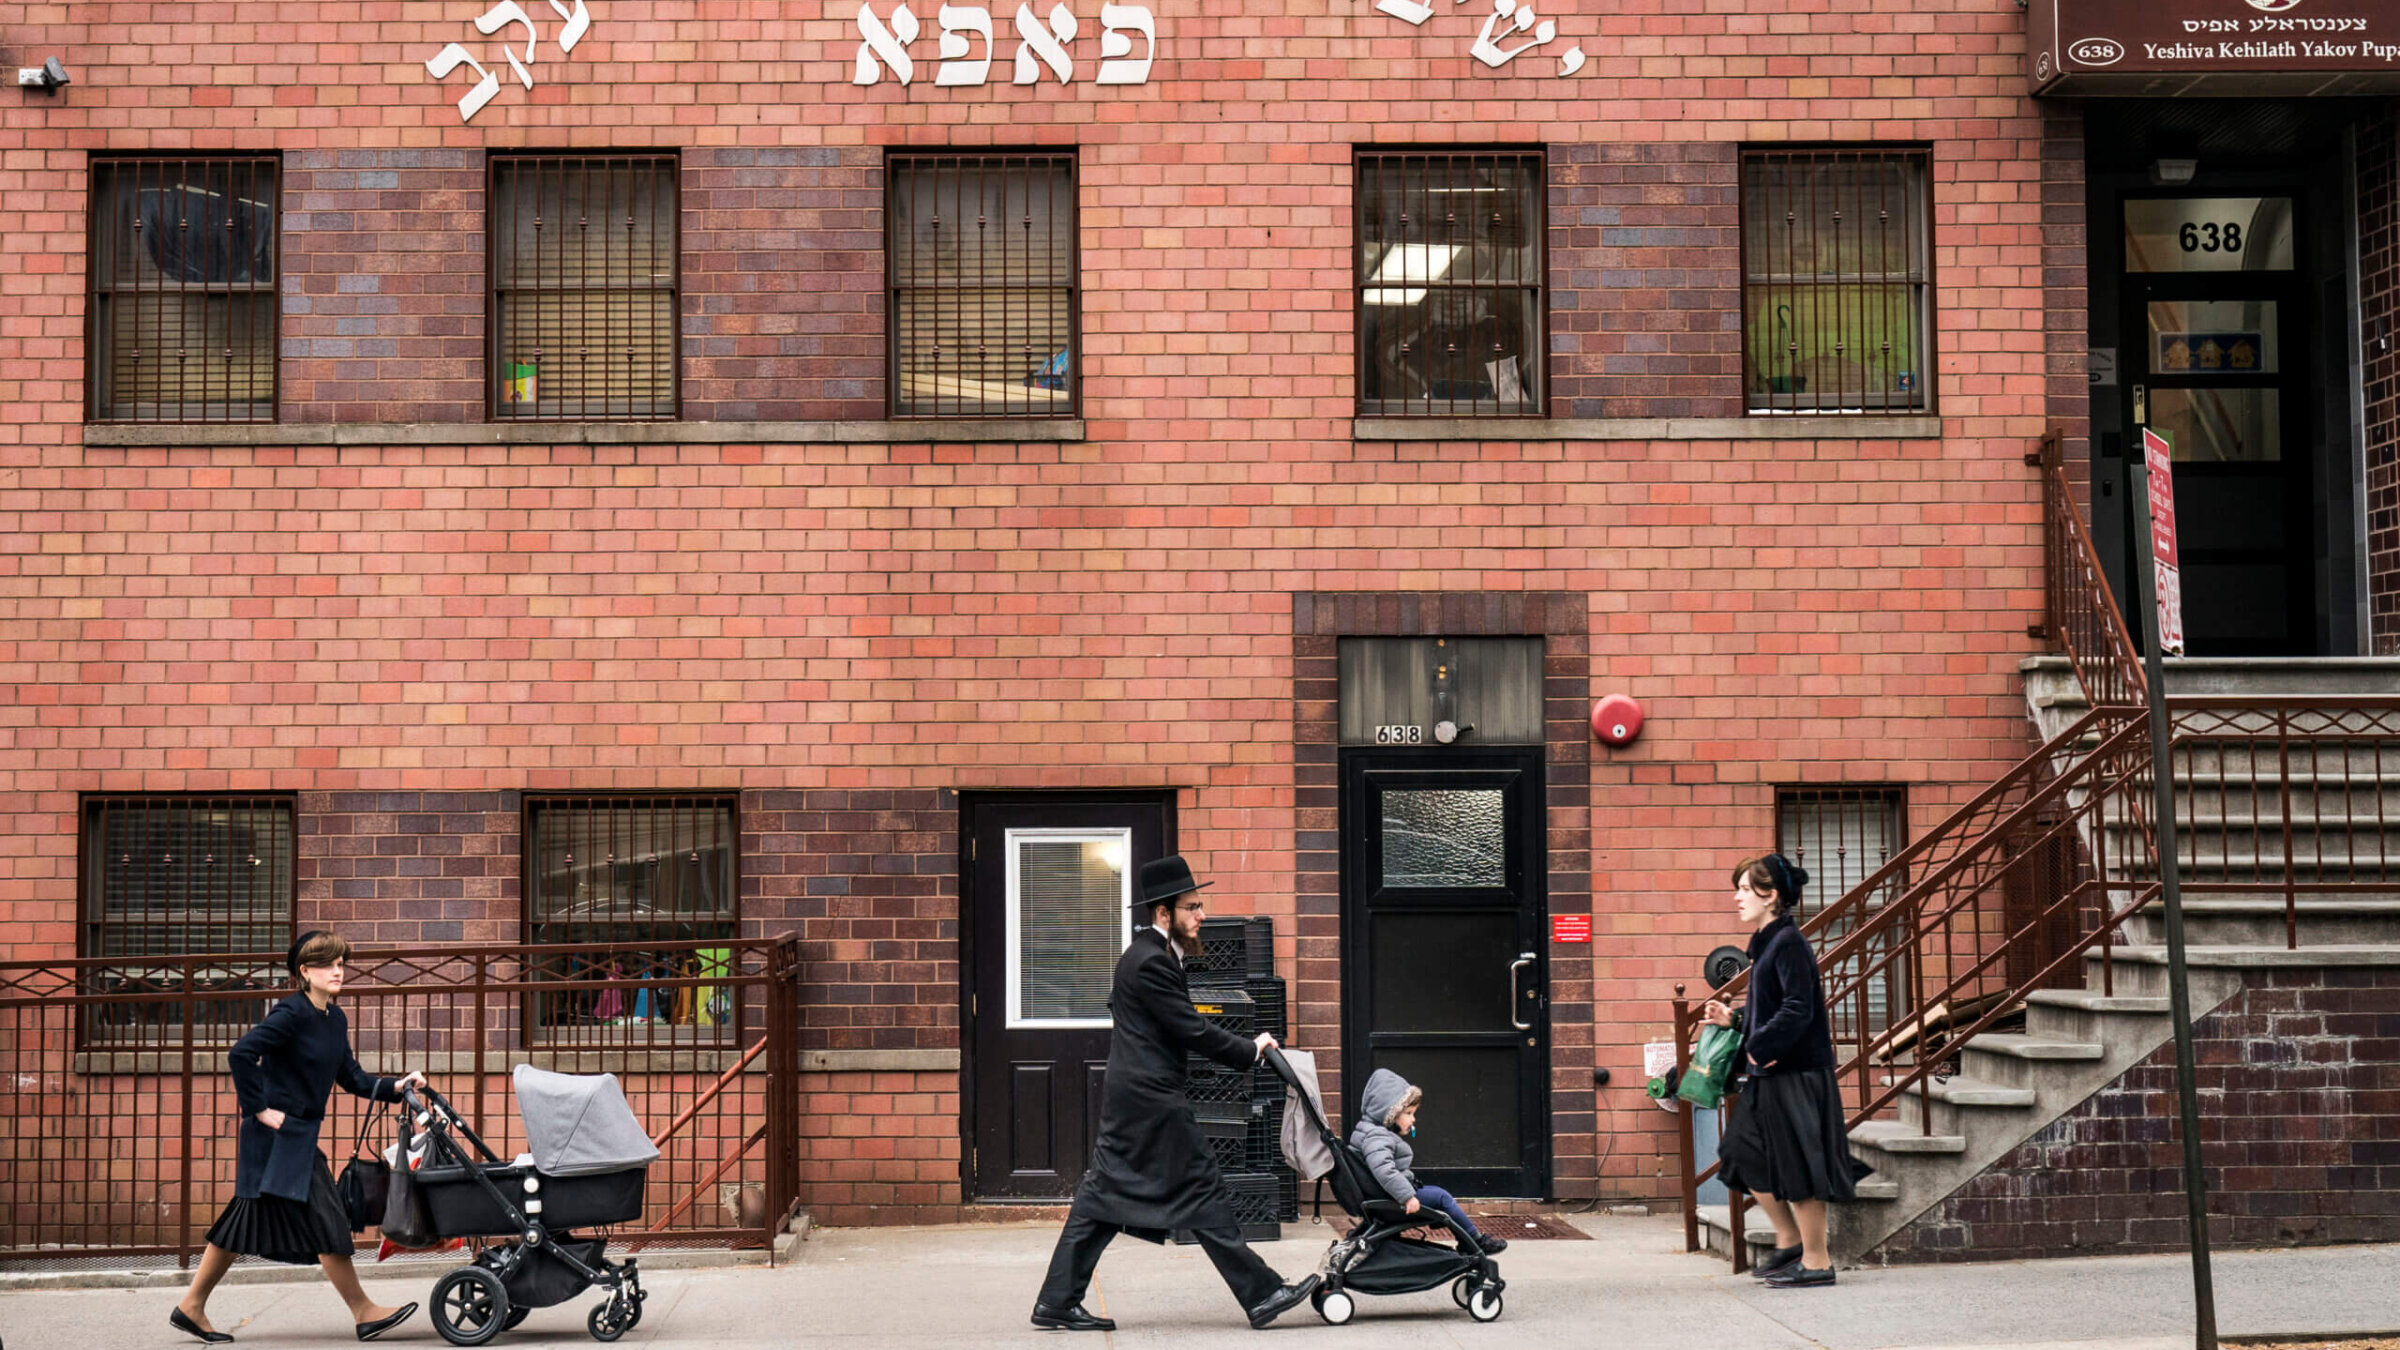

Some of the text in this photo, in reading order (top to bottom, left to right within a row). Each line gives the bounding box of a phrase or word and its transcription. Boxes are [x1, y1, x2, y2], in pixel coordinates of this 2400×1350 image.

[2182, 16, 2368, 32] צענטראלע אפיס
[852, 1, 1156, 86] פאפא
[2078, 45, 2115, 58] 638
[2144, 40, 2400, 62] Yeshiva Kehilath Yakov Pup
[2179, 222, 2242, 253] 638
[1377, 726, 1420, 743] 638
